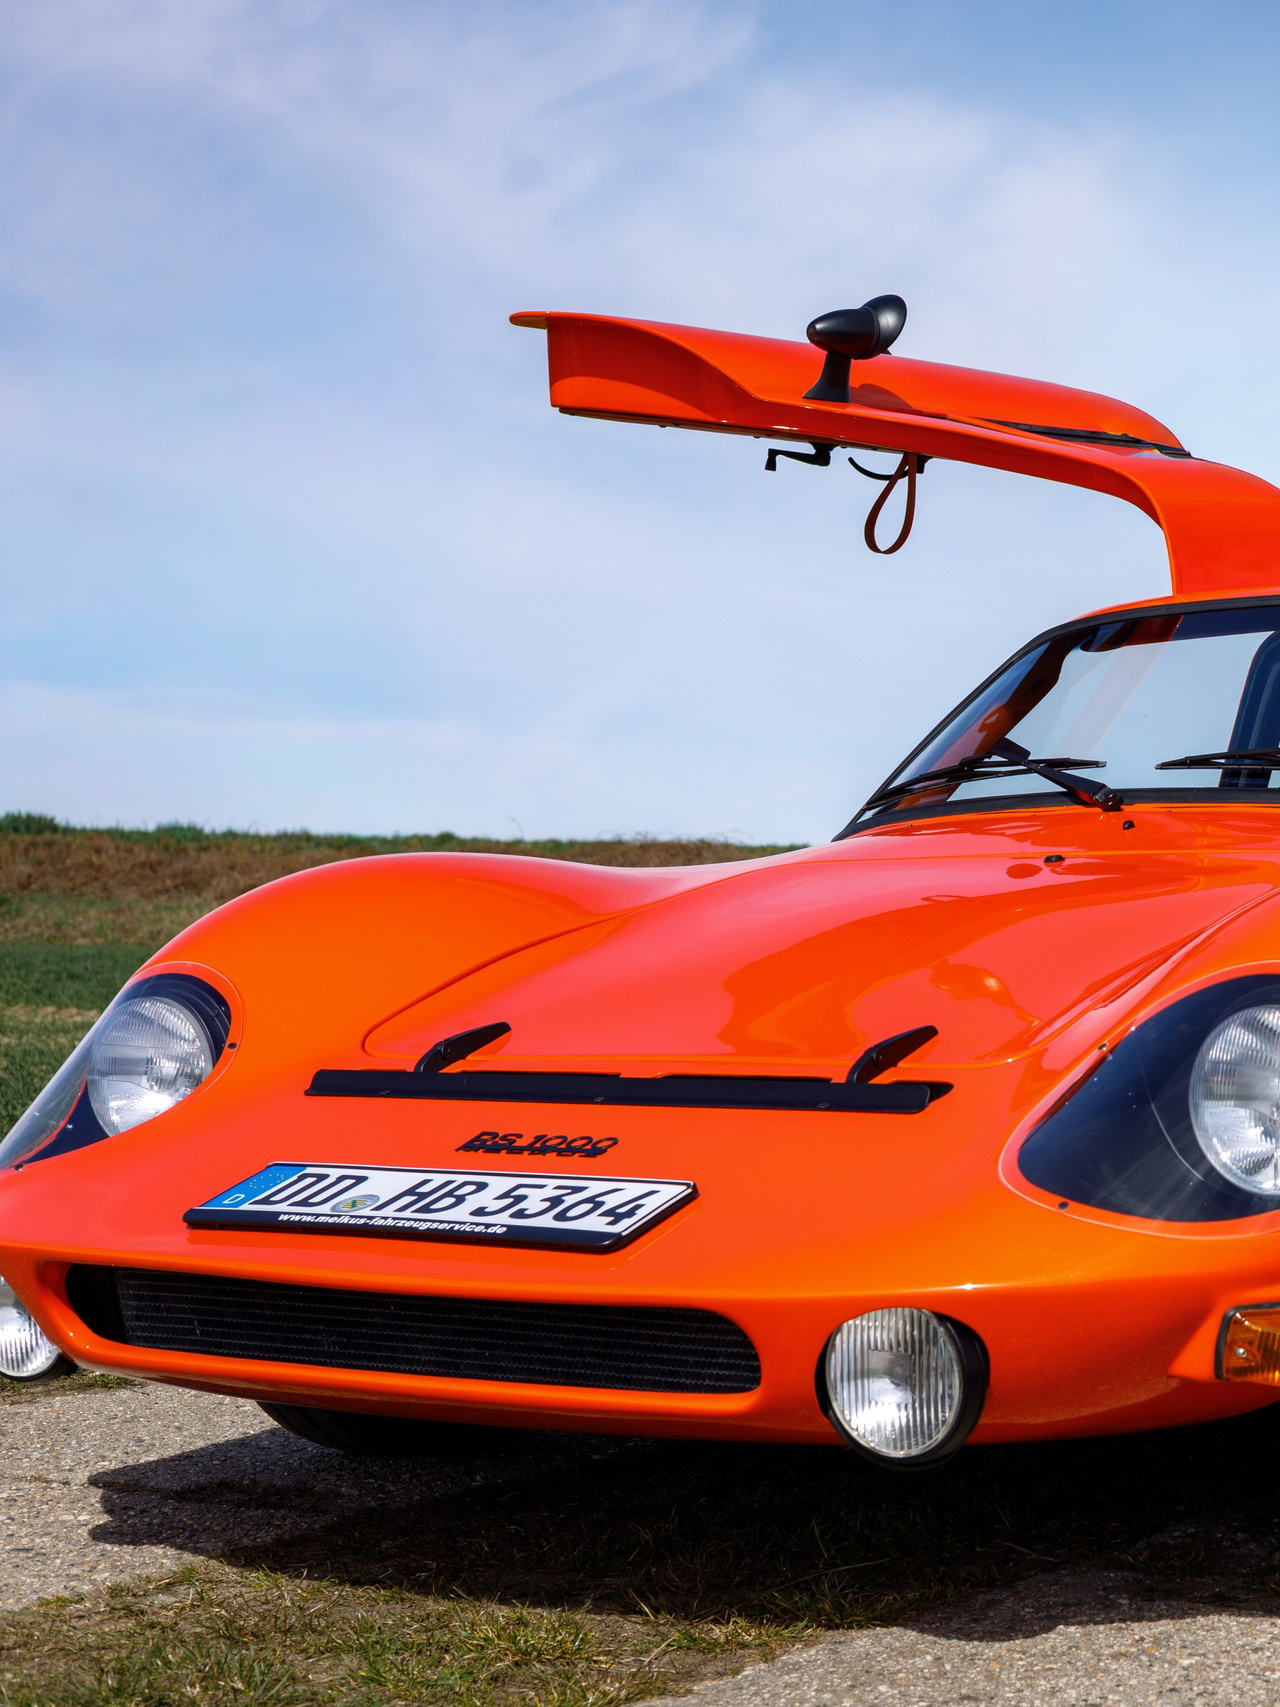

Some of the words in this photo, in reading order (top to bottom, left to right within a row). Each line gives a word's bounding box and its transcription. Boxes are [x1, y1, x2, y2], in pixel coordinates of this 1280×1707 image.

[222, 1193, 245, 1204] D
[248, 1173, 369, 1208] DD
[371, 1179, 489, 1214] HB
[469, 1183, 661, 1226] 5364
[277, 1213, 508, 1234] www.melkus-fahrzeugservice.de
